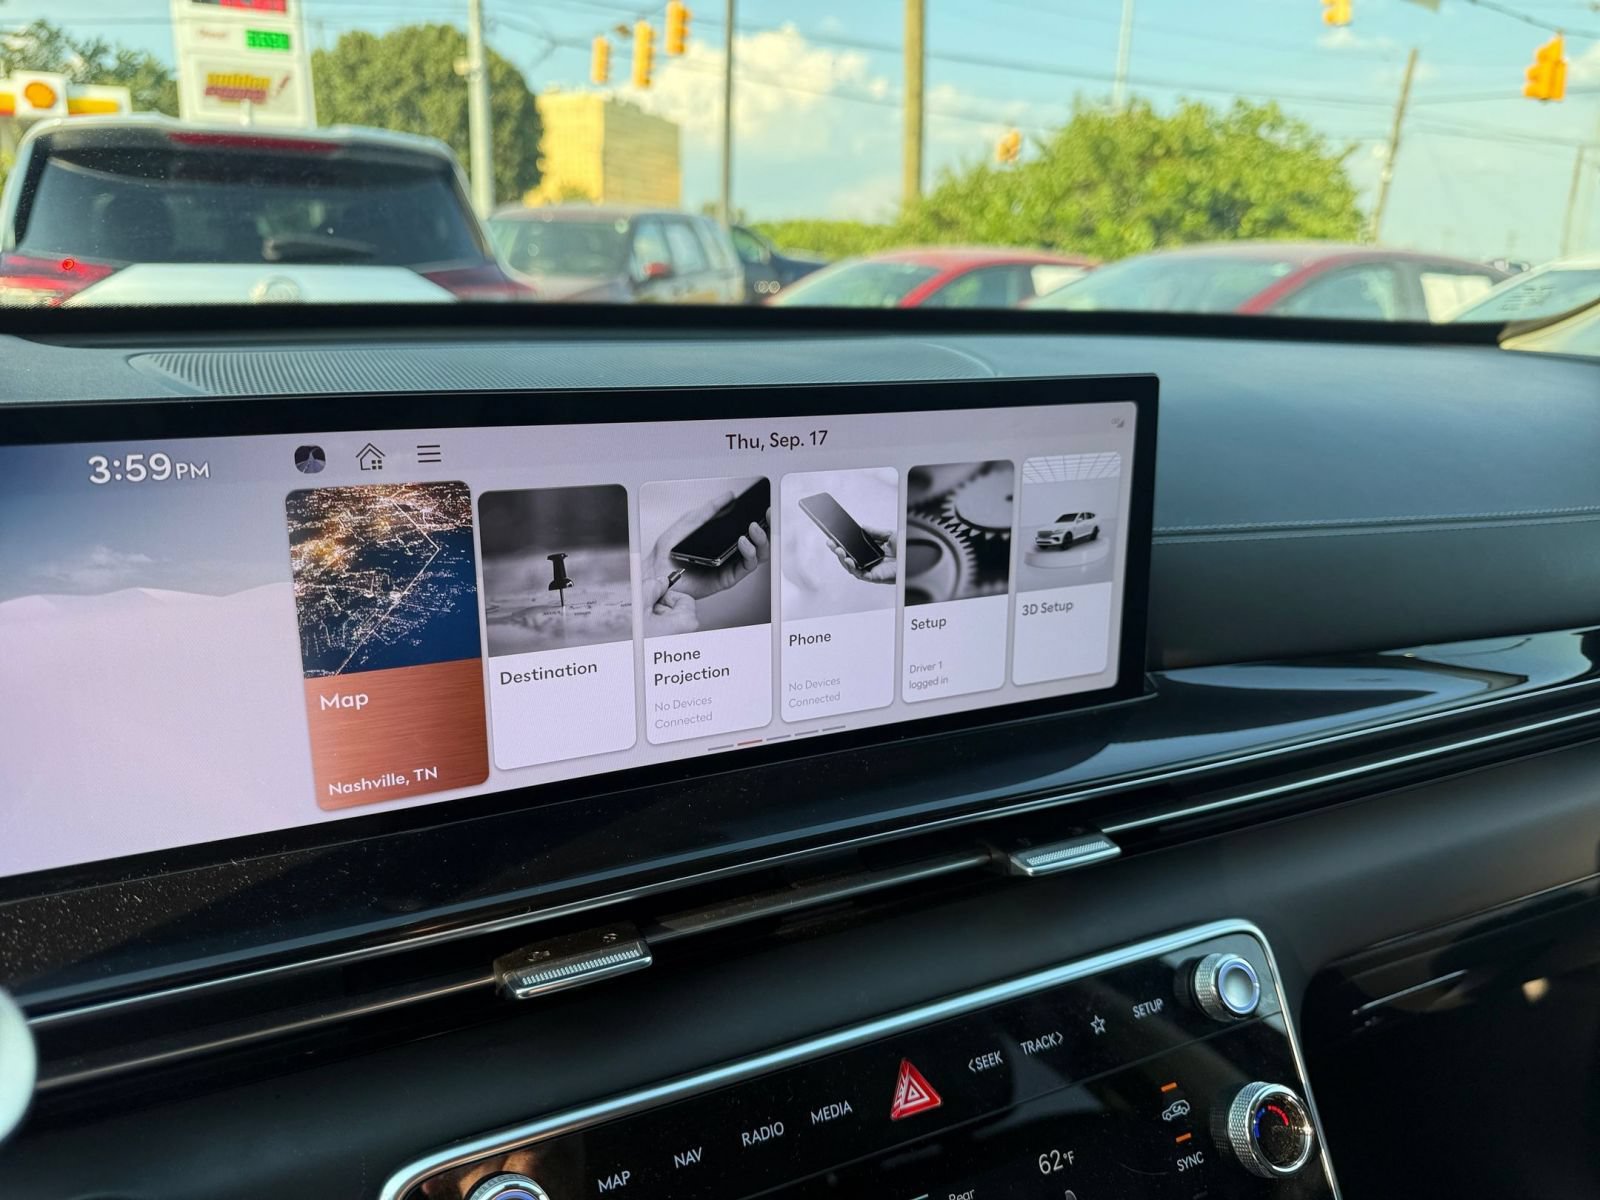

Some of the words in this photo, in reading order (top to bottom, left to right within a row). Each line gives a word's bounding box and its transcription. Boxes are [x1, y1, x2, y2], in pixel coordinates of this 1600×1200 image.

[725, 433, 765, 451] Thu,
[769, 432, 805, 451] Sep.
[809, 430, 829, 446] 17
[88, 453, 172, 484] 3:59
[174, 461, 211, 481] PM
[1022, 603, 1037, 617] 3D
[1041, 602, 1075, 615] Setup
[911, 617, 947, 631] Setup
[789, 632, 832, 647] Phone
[653, 650, 701, 665] Phone
[500, 661, 598, 686] Destination
[653, 665, 730, 687] Projection
[909, 664, 937, 675] Driver
[938, 661, 943, 670] 1
[789, 681, 803, 692] No
[805, 677, 841, 691] Devices
[909, 677, 938, 691] logged
[940, 675, 949, 686] in
[320, 692, 369, 712] Map
[655, 701, 671, 713] No
[672, 696, 713, 710] Devices
[788, 692, 841, 709] Connected
[654, 711, 713, 730] Connected
[328, 772, 411, 797] Nashville,
[412, 766, 438, 782] TN
[1132, 998, 1164, 1019] SETUP
[810, 1100, 853, 1125] MEDIA
[741, 1121, 785, 1147] RADIO
[674, 1146, 703, 1169] NAV
[1176, 1151, 1205, 1173] SYNC
[598, 1171, 631, 1193] MAP
